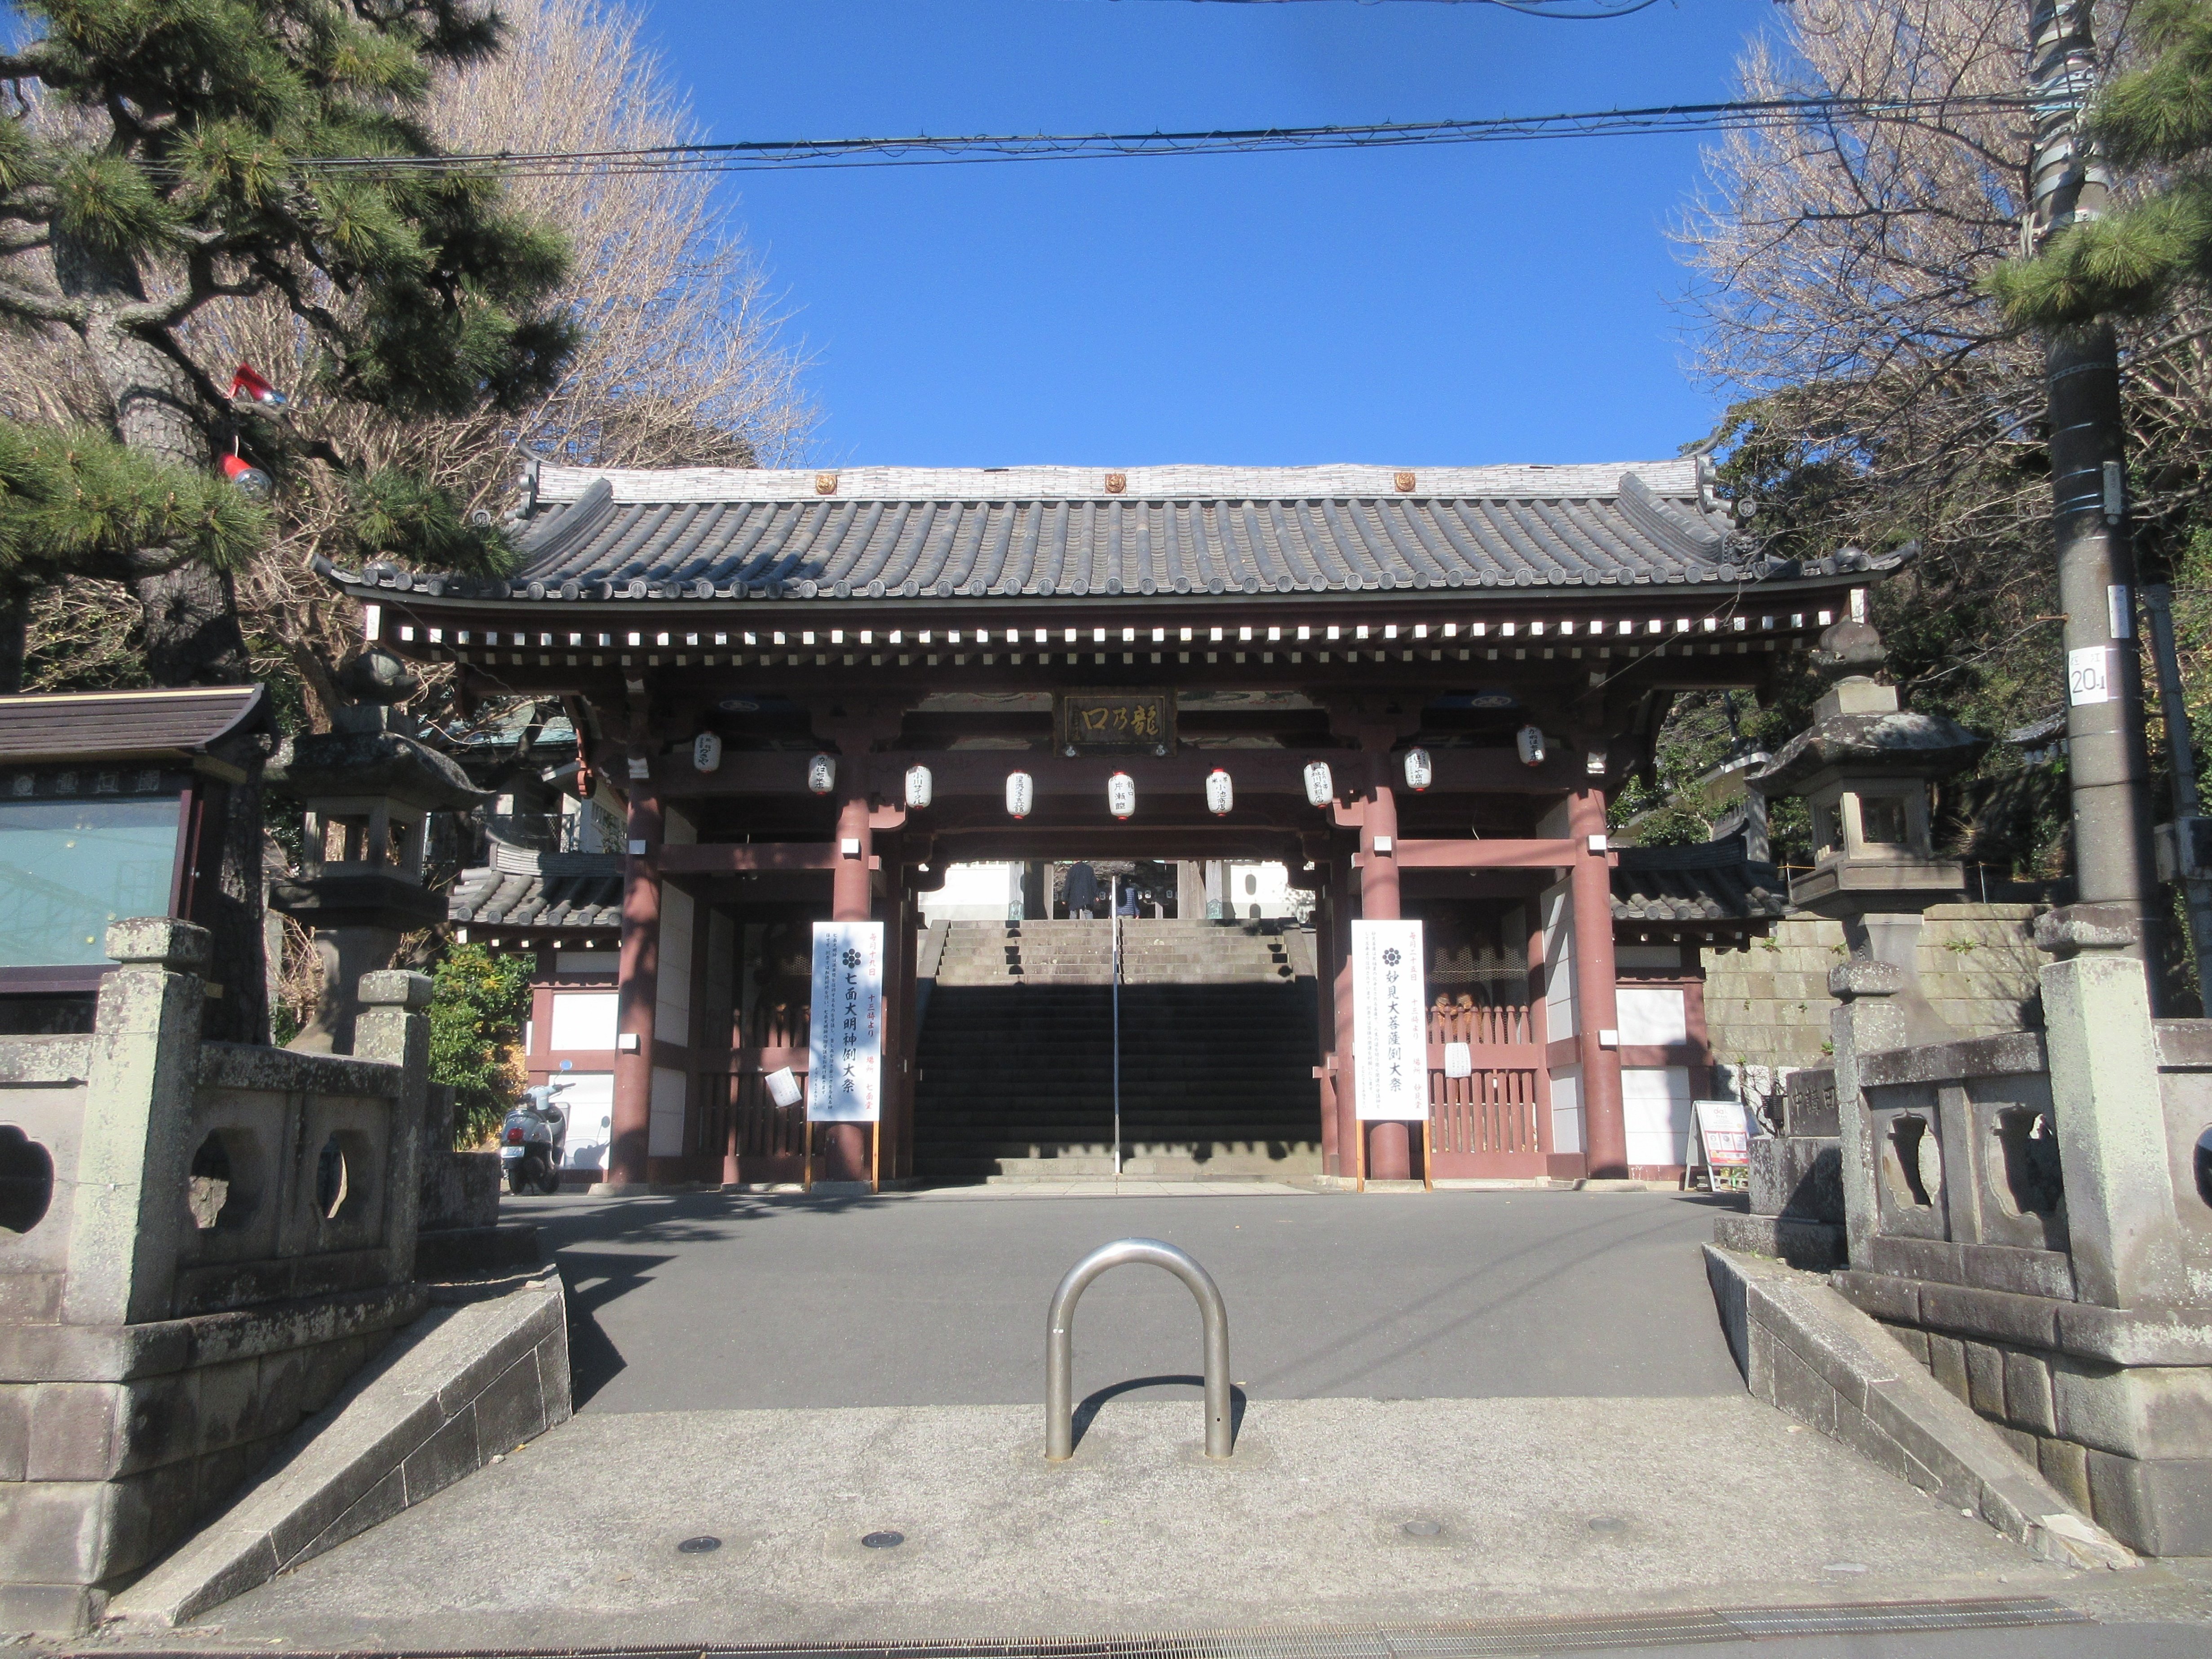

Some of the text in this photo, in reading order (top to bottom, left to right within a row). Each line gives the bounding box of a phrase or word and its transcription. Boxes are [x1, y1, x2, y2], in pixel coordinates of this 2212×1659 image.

[2071, 668, 2106, 695] 20-1
[913, 772, 925, 805] 小川サイクル
[1216, 784, 1227, 810] 小池商店
[841, 972, 858, 1093] 七面大明神例大祭
[865, 933, 877, 1110] 毎月十九日 十三時より 場所 七面堂
[1385, 970, 1402, 1092] 妙見大菩薩例大祭
[1409, 932, 1422, 1110] 毎月二十五日 十三時より 場所 妙見堂
